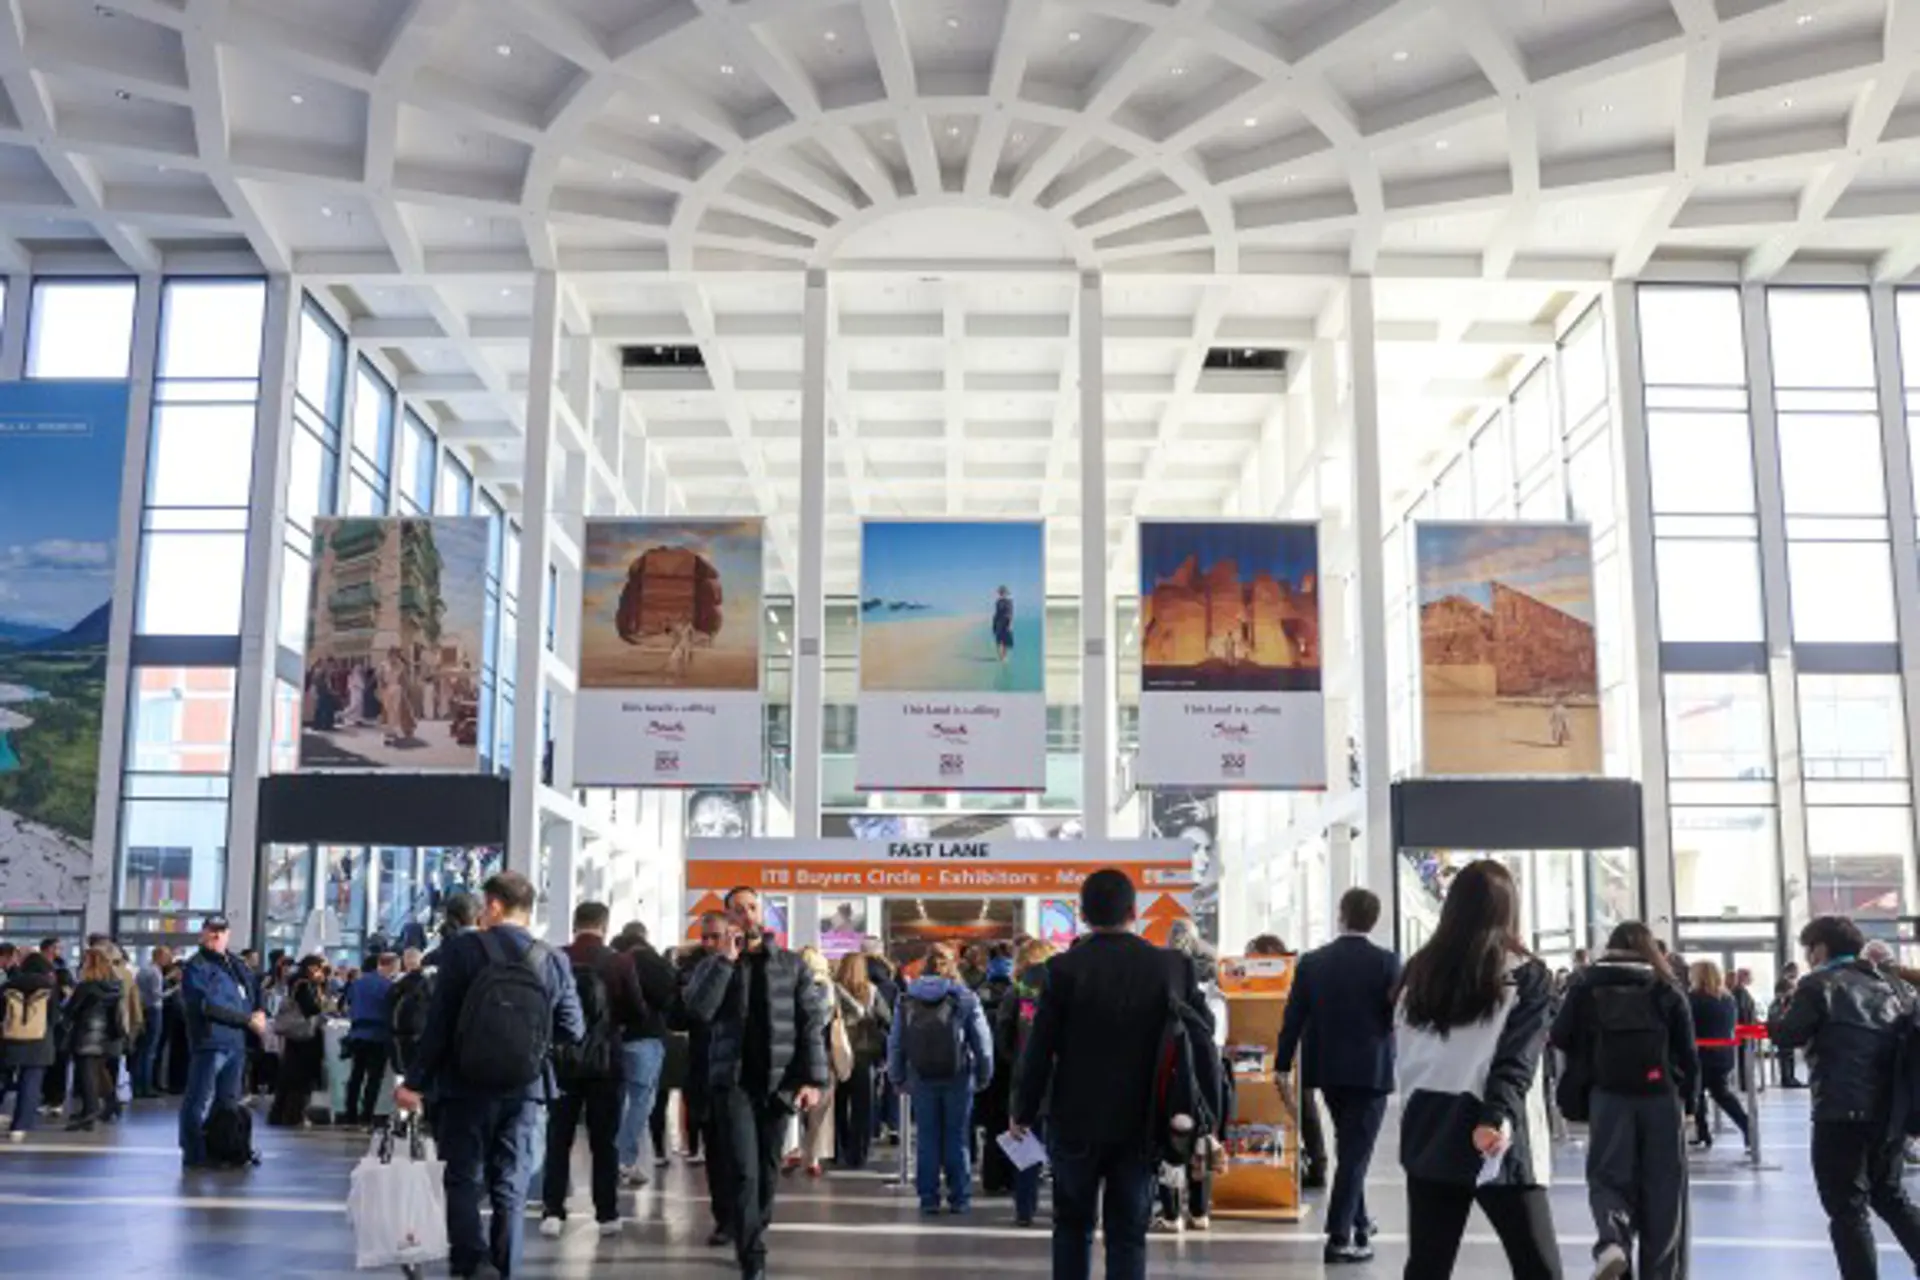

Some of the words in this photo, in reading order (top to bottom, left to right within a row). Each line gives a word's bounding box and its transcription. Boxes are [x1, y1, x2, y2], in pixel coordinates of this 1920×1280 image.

[887, 843, 933, 857] FAST
[939, 843, 990, 857] LANE
[760, 868, 790, 884] ITB
[796, 868, 862, 887] Buyers
[866, 868, 921, 885] Circle
[938, 868, 1039, 886] Exhibitors
